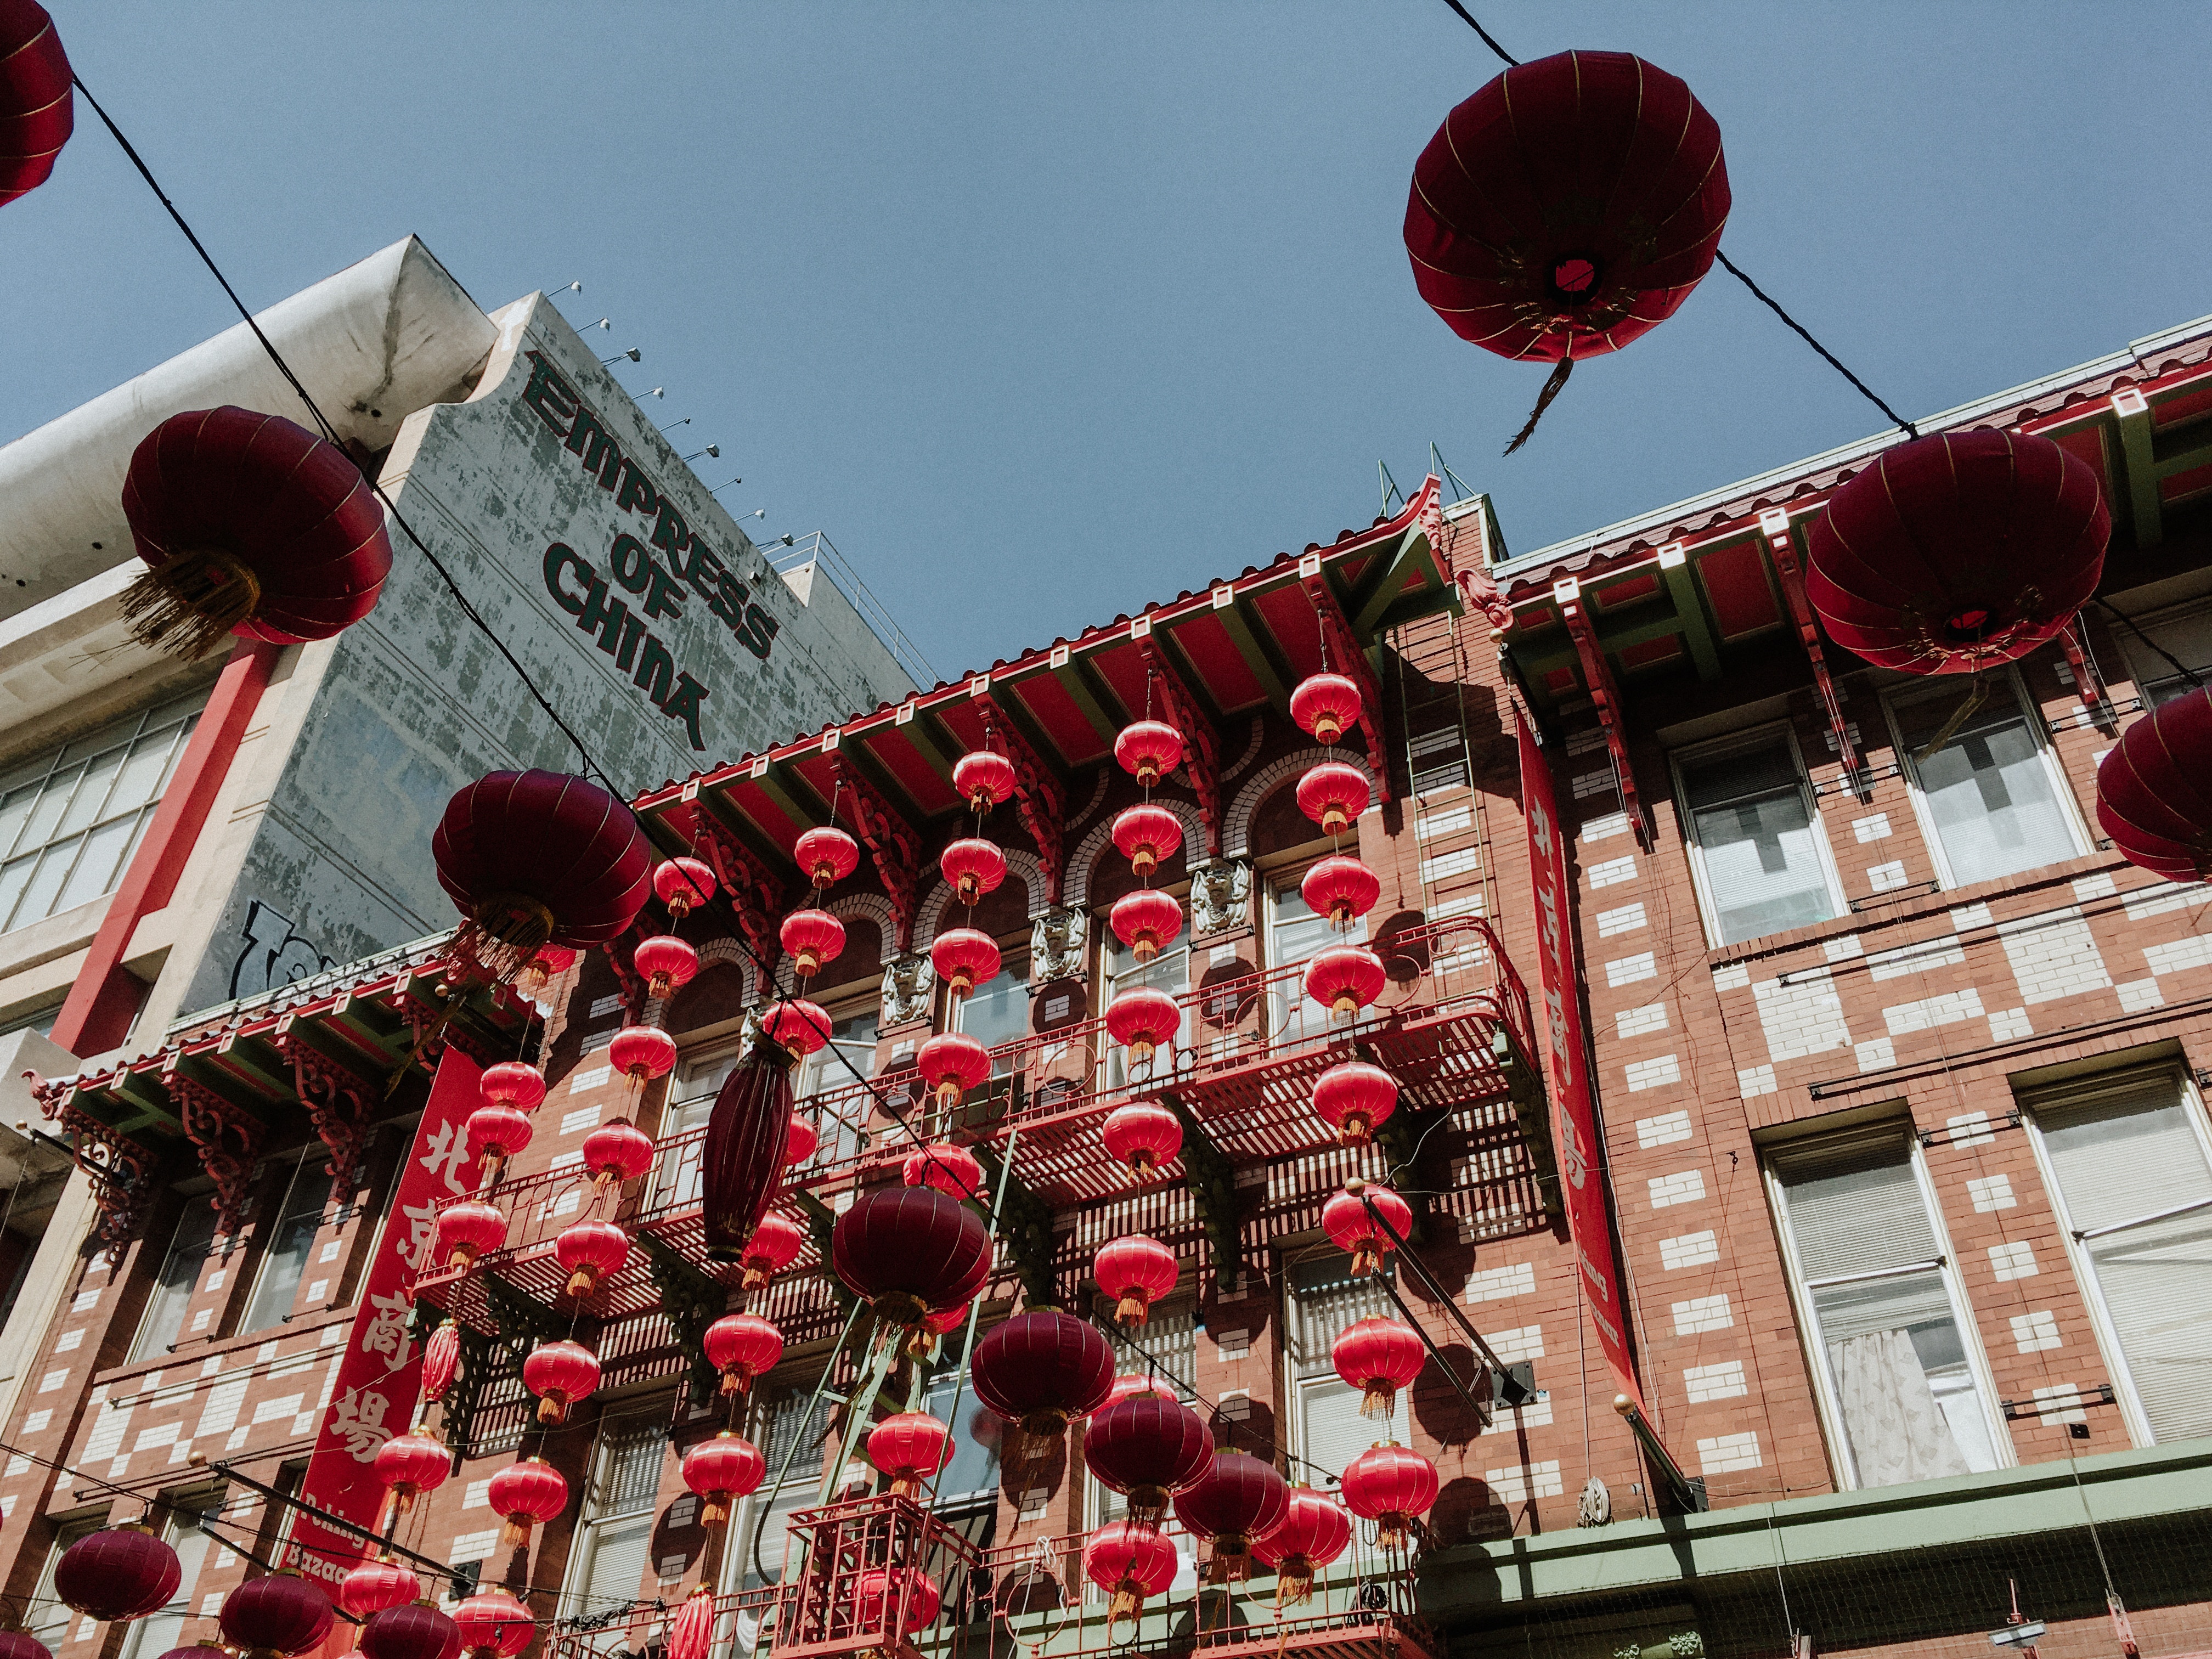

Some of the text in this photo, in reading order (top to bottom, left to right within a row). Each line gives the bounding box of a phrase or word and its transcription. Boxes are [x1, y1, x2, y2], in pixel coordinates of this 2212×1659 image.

[522, 349, 780, 659] EMPRESS
[611, 533, 687, 620] OF
[543, 542, 710, 752] CHINA
[286, 1536, 350, 1584] Bazaa
